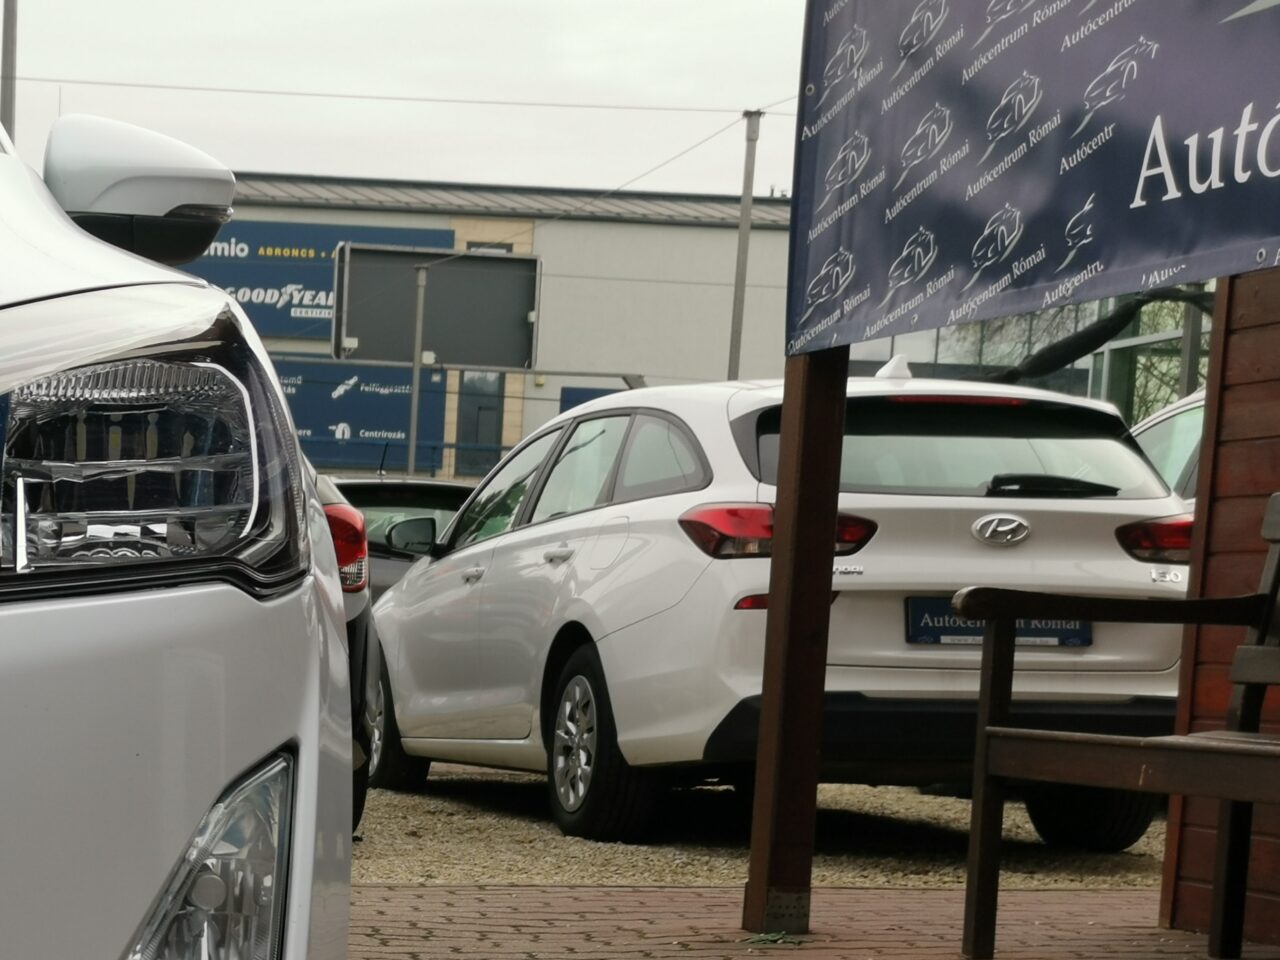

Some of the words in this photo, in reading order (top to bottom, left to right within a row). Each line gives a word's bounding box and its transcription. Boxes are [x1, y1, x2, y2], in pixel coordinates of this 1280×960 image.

[962, 23, 1028, 86] Autócentrum
[965, 142, 1027, 201] Autócentrum
[1028, 109, 1062, 147] Római
[1059, 123, 1116, 176] Autócentr
[884, 168, 937, 224] Autócentrum
[939, 139, 969, 174] Római
[203, 237, 249, 258] mio
[1012, 243, 1046, 276] Római
[863, 292, 924, 340] Autócentrum
[926, 265, 955, 298] Római
